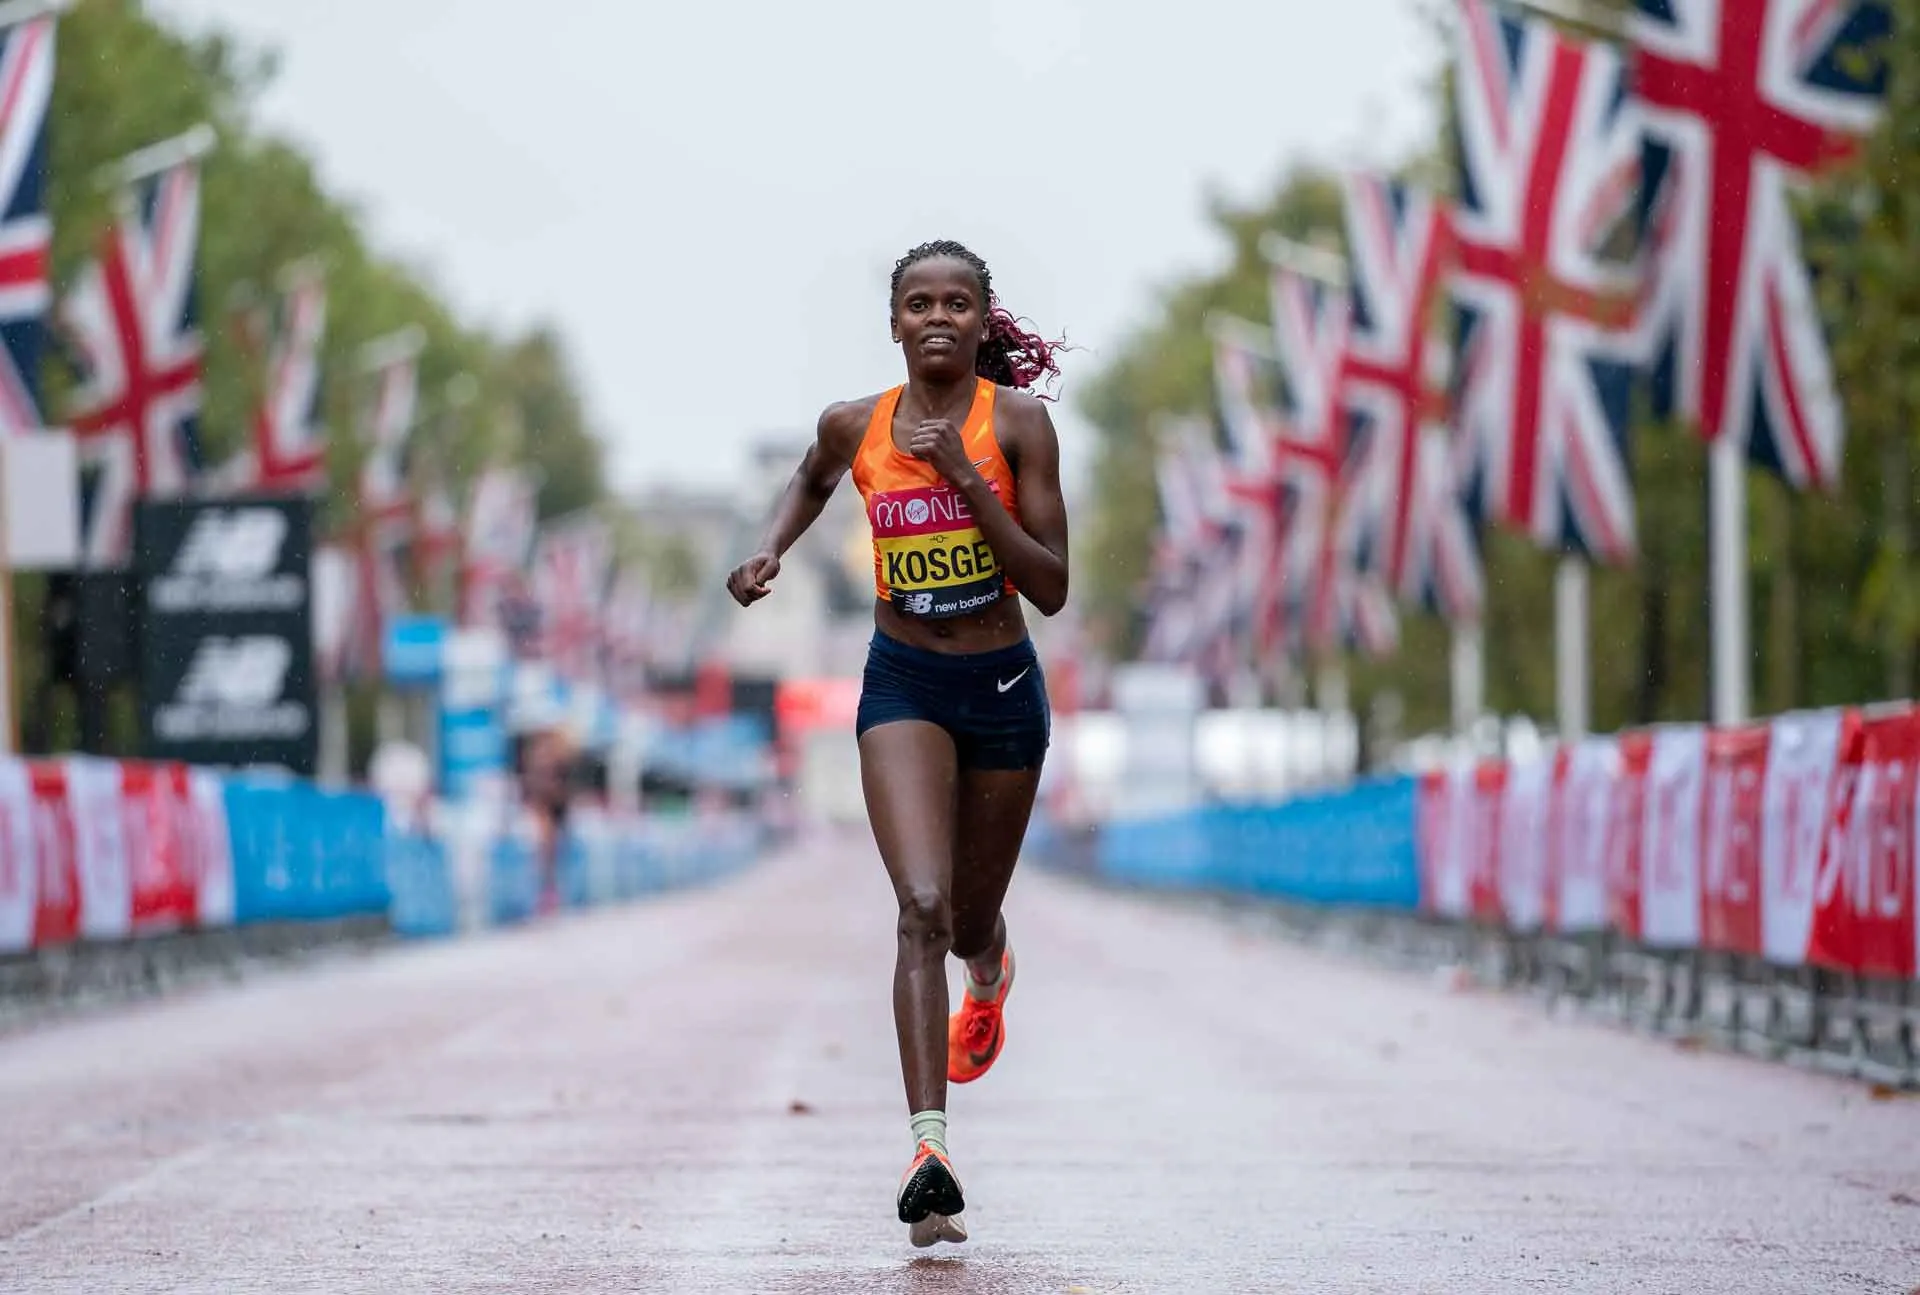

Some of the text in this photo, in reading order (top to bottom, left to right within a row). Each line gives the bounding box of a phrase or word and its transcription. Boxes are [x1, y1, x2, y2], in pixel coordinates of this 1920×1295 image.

[876, 494, 973, 528] MONE
[887, 541, 997, 585] KOSGE
[935, 602, 957, 612] new
